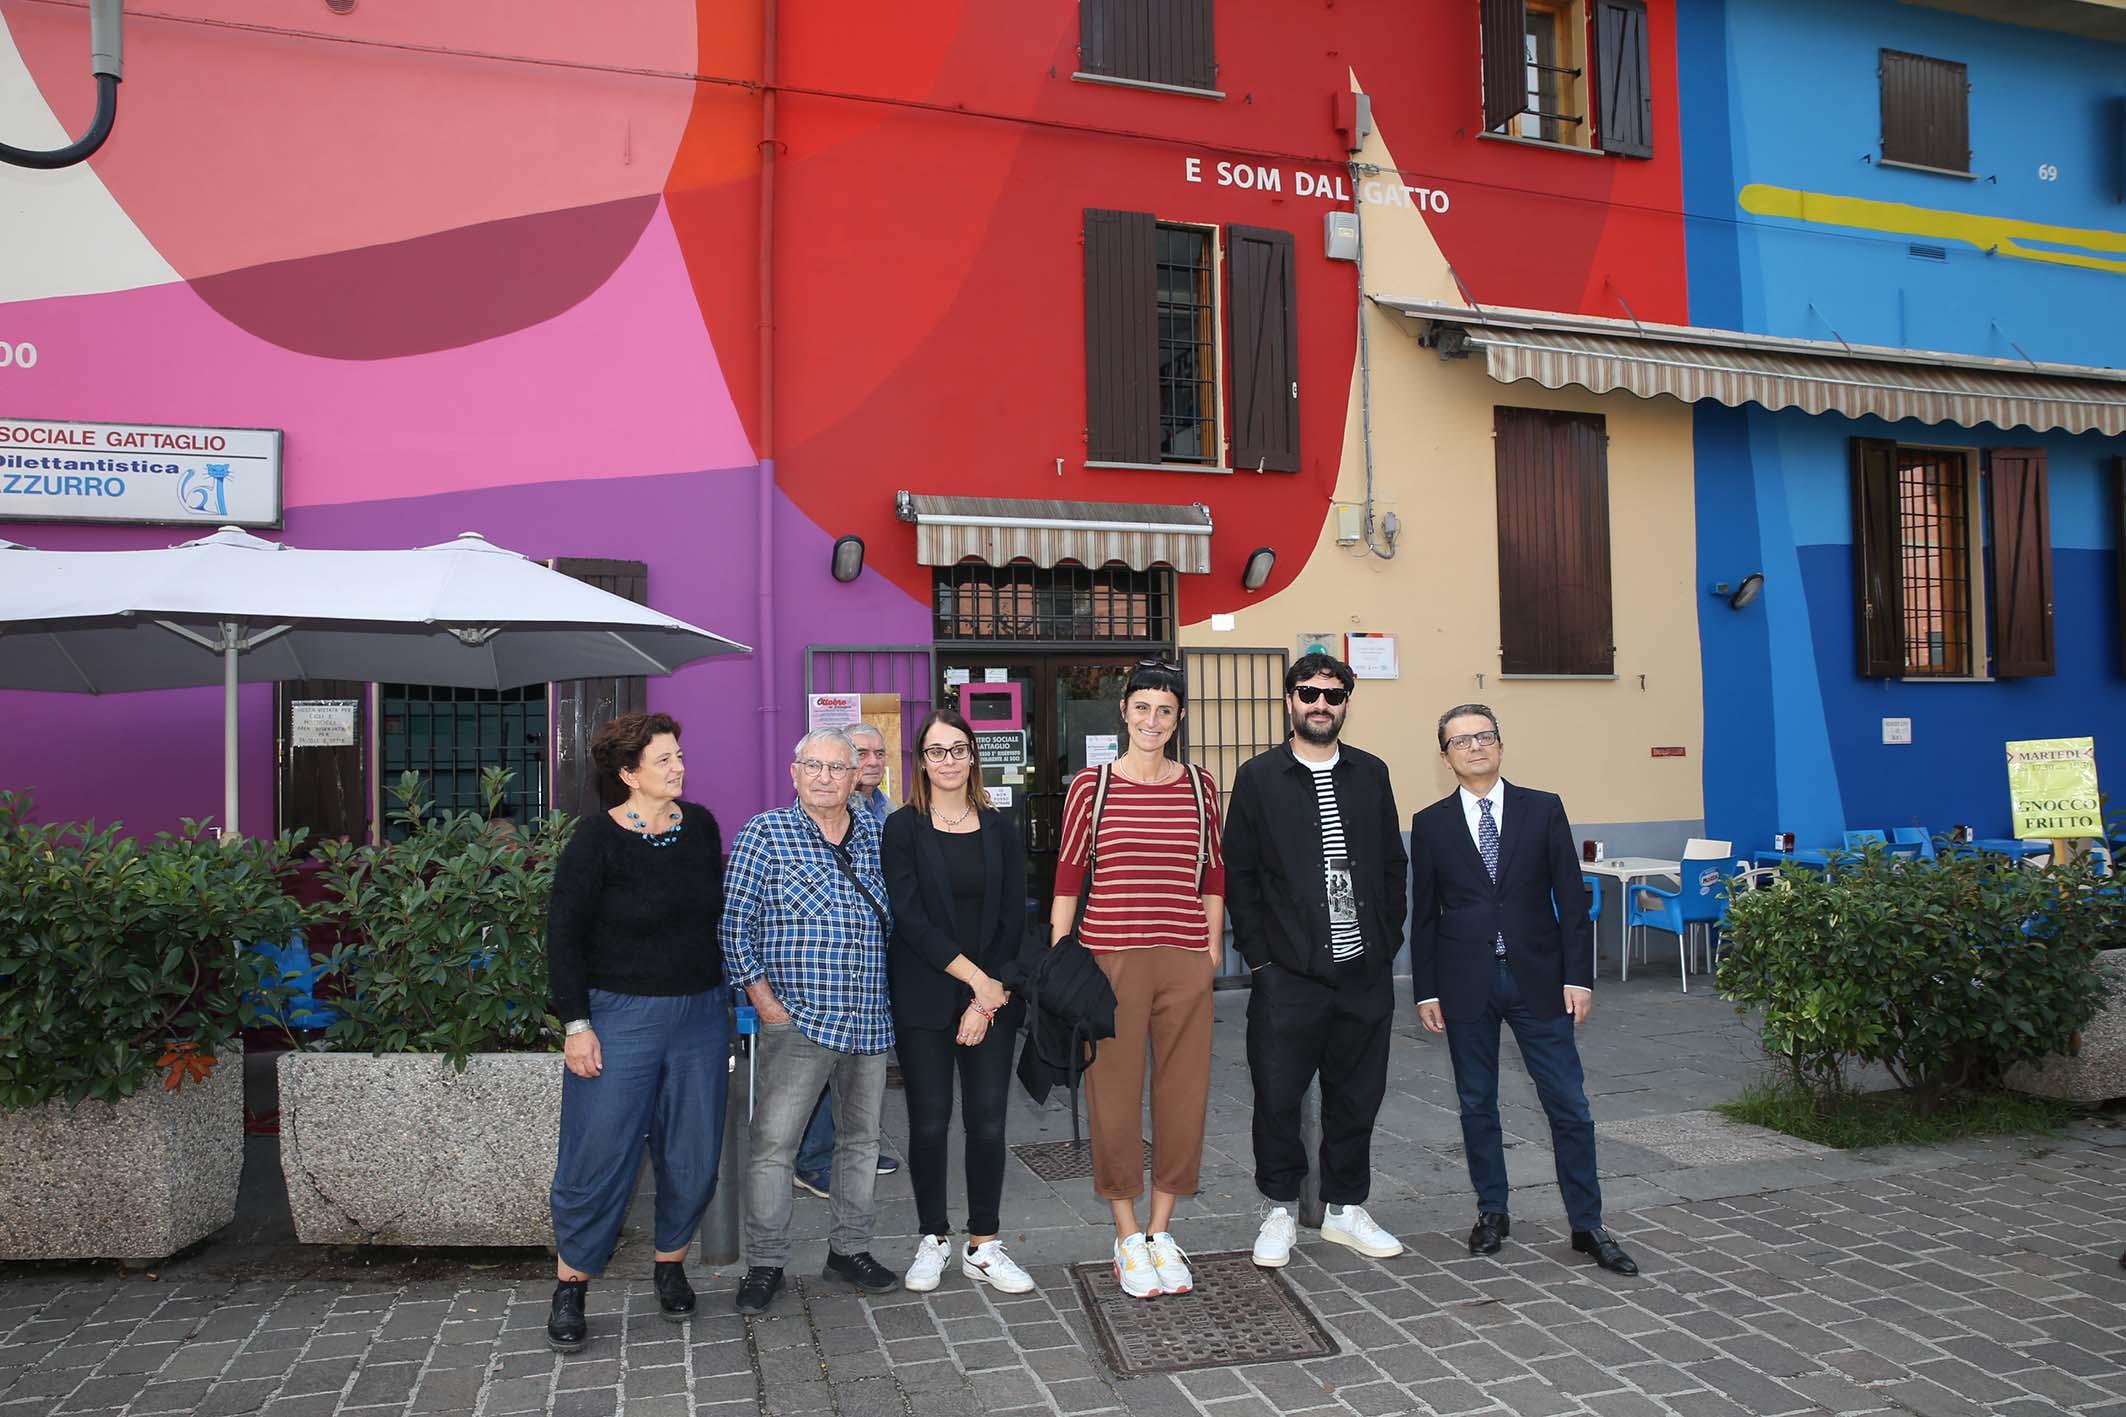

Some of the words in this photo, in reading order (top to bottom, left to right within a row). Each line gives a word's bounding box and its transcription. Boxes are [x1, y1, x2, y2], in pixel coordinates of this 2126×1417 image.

[2038, 163, 2058, 182] 69
[1185, 157, 1202, 183] E
[1216, 161, 1282, 193] SOM
[1295, 171, 1350, 201] DAL
[1364, 180, 1450, 214] GATTO
[0, 426, 96, 446] SOCIALE
[106, 431, 226, 451] GATTAGLIO
[0, 474, 126, 497] ZZURRO
[992, 735, 1019, 743] SOCIALE
[2018, 799, 2097, 813] GNOCCO
[2025, 816, 2093, 829] FRITTO
